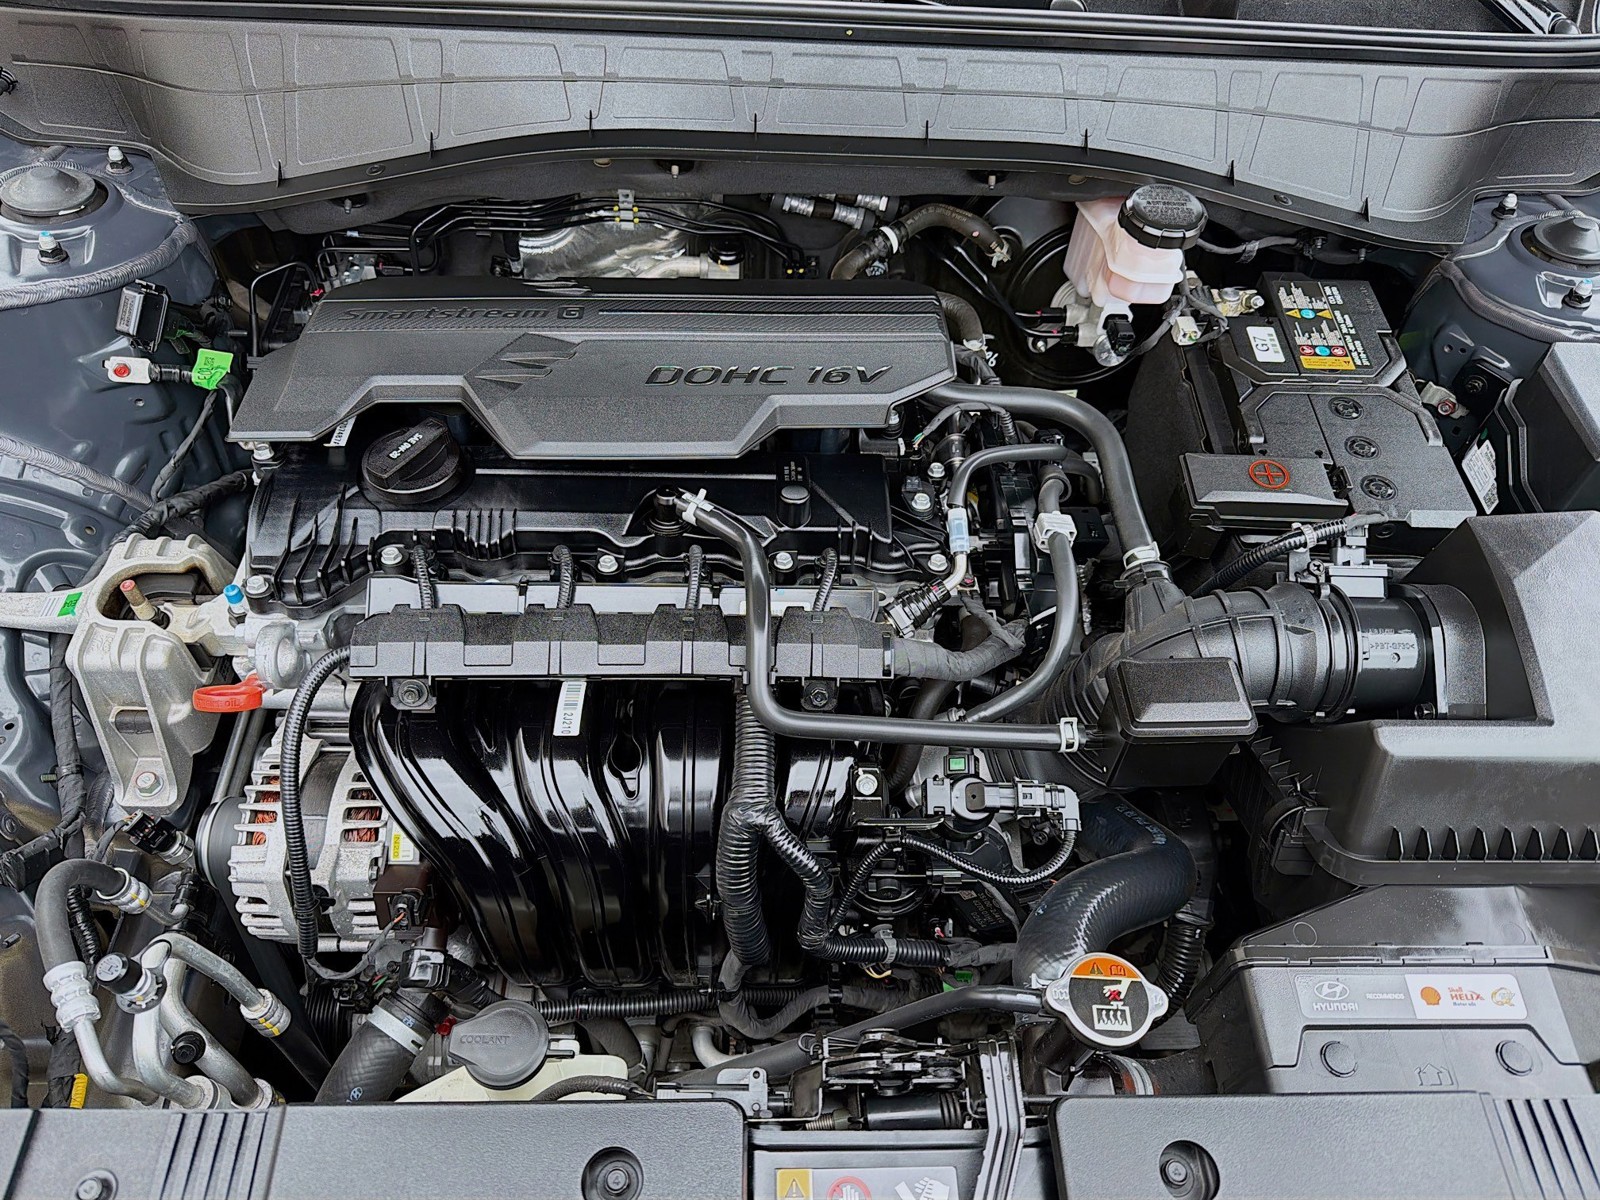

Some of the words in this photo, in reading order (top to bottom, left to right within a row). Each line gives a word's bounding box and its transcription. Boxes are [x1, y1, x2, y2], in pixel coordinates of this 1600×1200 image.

[338, 306, 549, 321] Smartstream
[560, 307, 582, 319] G
[1253, 336, 1270, 352] G7
[644, 364, 795, 386] DOHC
[807, 364, 893, 386] 16V
[225, 698, 241, 708] OIL
[561, 712, 574, 735] 2J210
[1365, 992, 1405, 1000] RECOMMENDS
[1450, 992, 1485, 1001] HELIX
[1312, 1001, 1359, 1012] HYUNDAI
[459, 1034, 511, 1046] COOLANT
